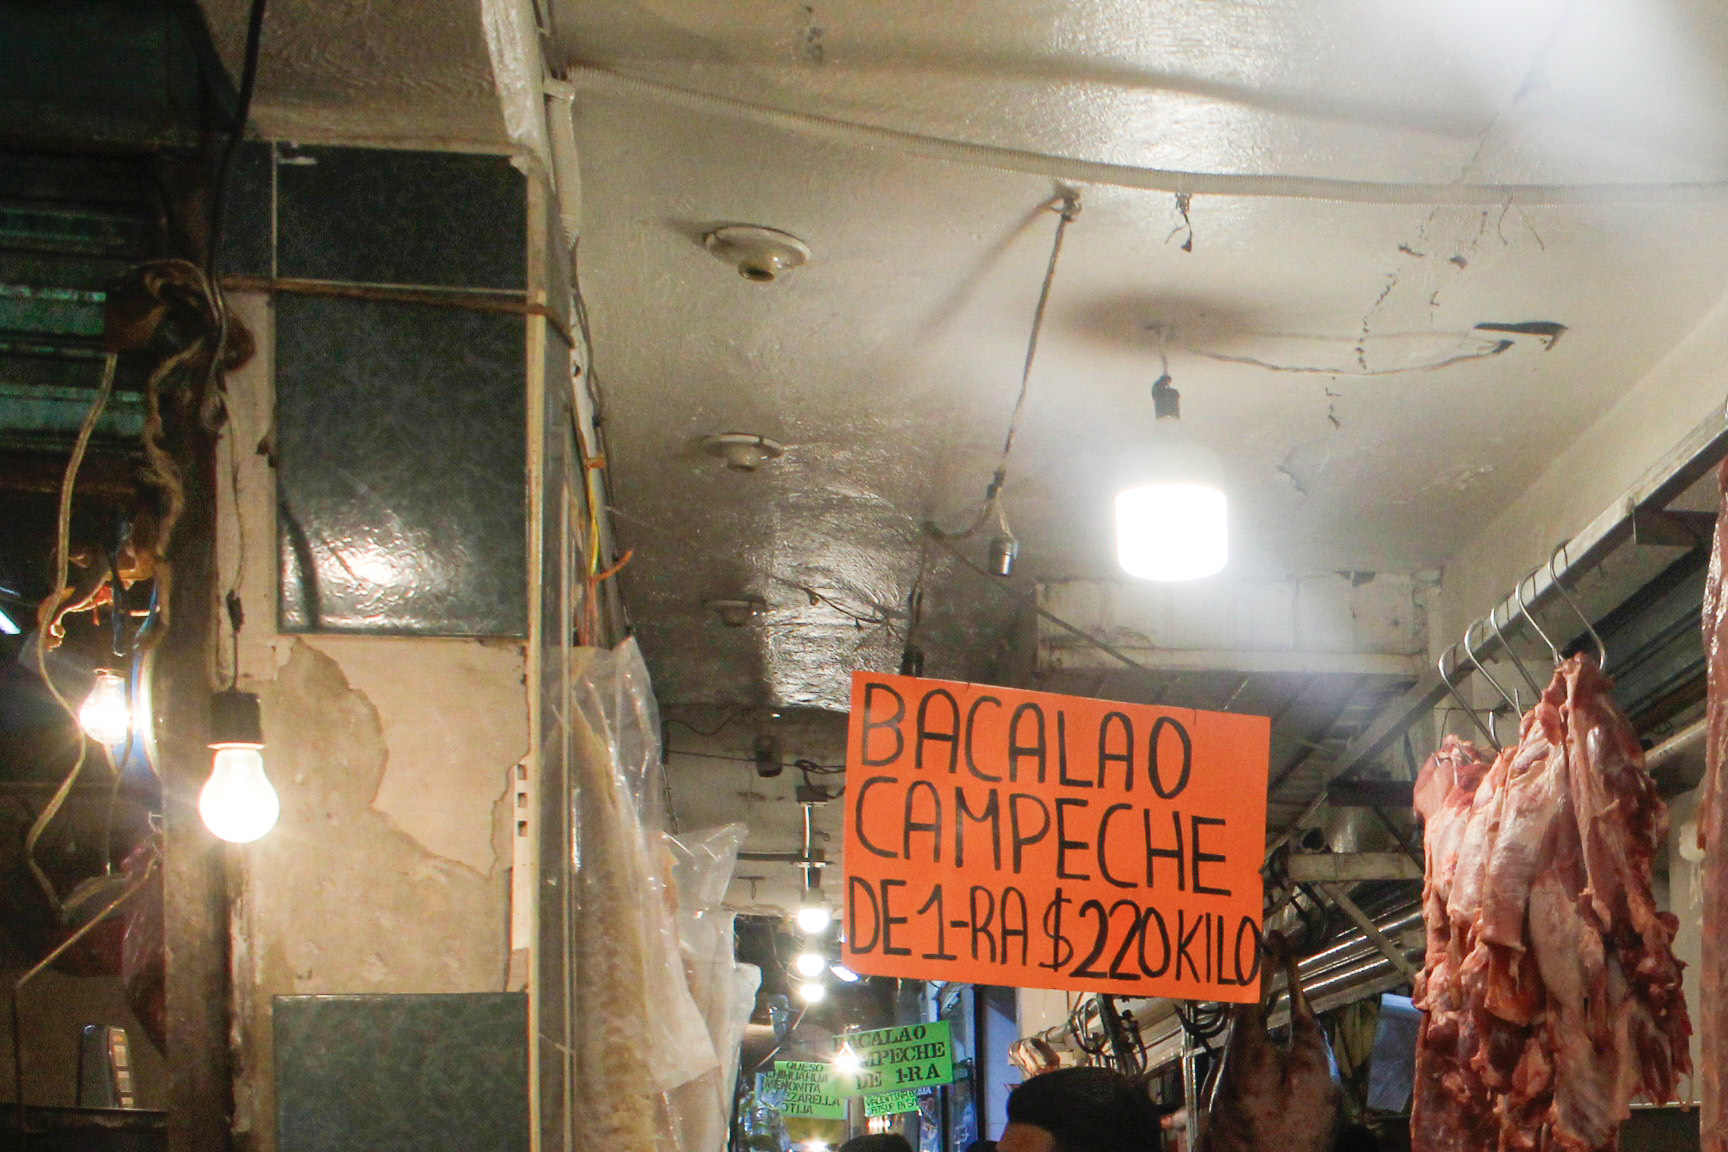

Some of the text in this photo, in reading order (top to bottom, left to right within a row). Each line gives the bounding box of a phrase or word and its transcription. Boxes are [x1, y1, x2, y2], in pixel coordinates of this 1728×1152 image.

[861, 682, 1193, 799] BACALAO
[856, 776, 1231, 896] CAMPECHE
[849, 876, 1260, 987] DE 1-RA $220 KILO
[786, 1062, 824, 1073] QUESO
[856, 1072, 882, 1090] DE
